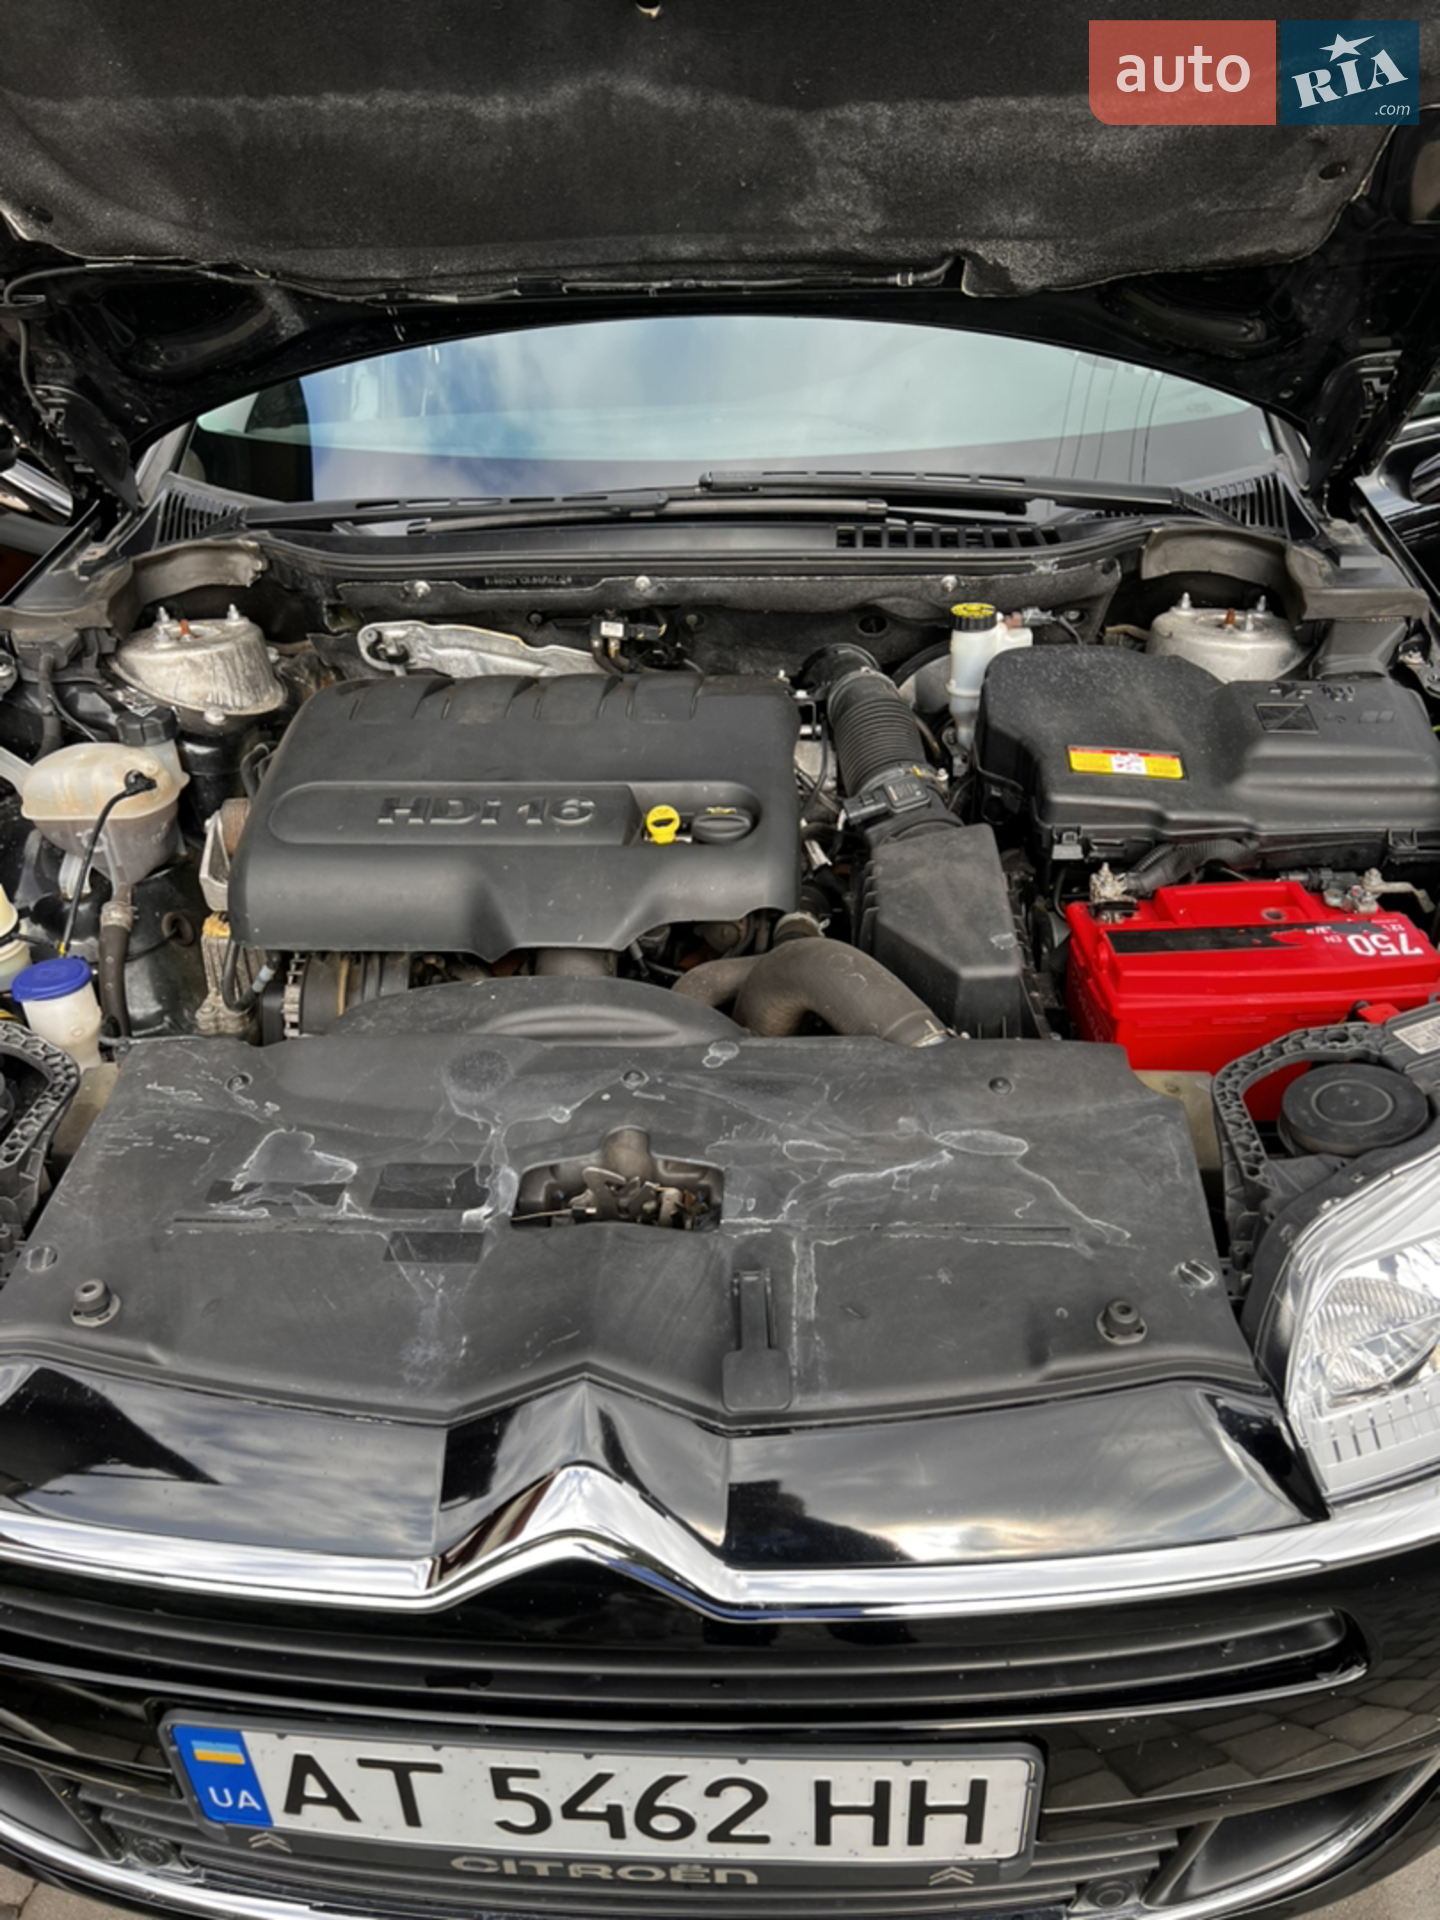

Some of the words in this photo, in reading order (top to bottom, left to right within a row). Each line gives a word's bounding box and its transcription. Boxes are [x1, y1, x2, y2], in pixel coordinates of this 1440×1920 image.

[517, 798, 595, 824] 16
[1347, 932, 1424, 957] 750
[208, 1786, 262, 1811] UA
[283, 1753, 444, 1828] AT
[489, 1766, 771, 1844] 5462
[814, 1778, 988, 1847] HH
